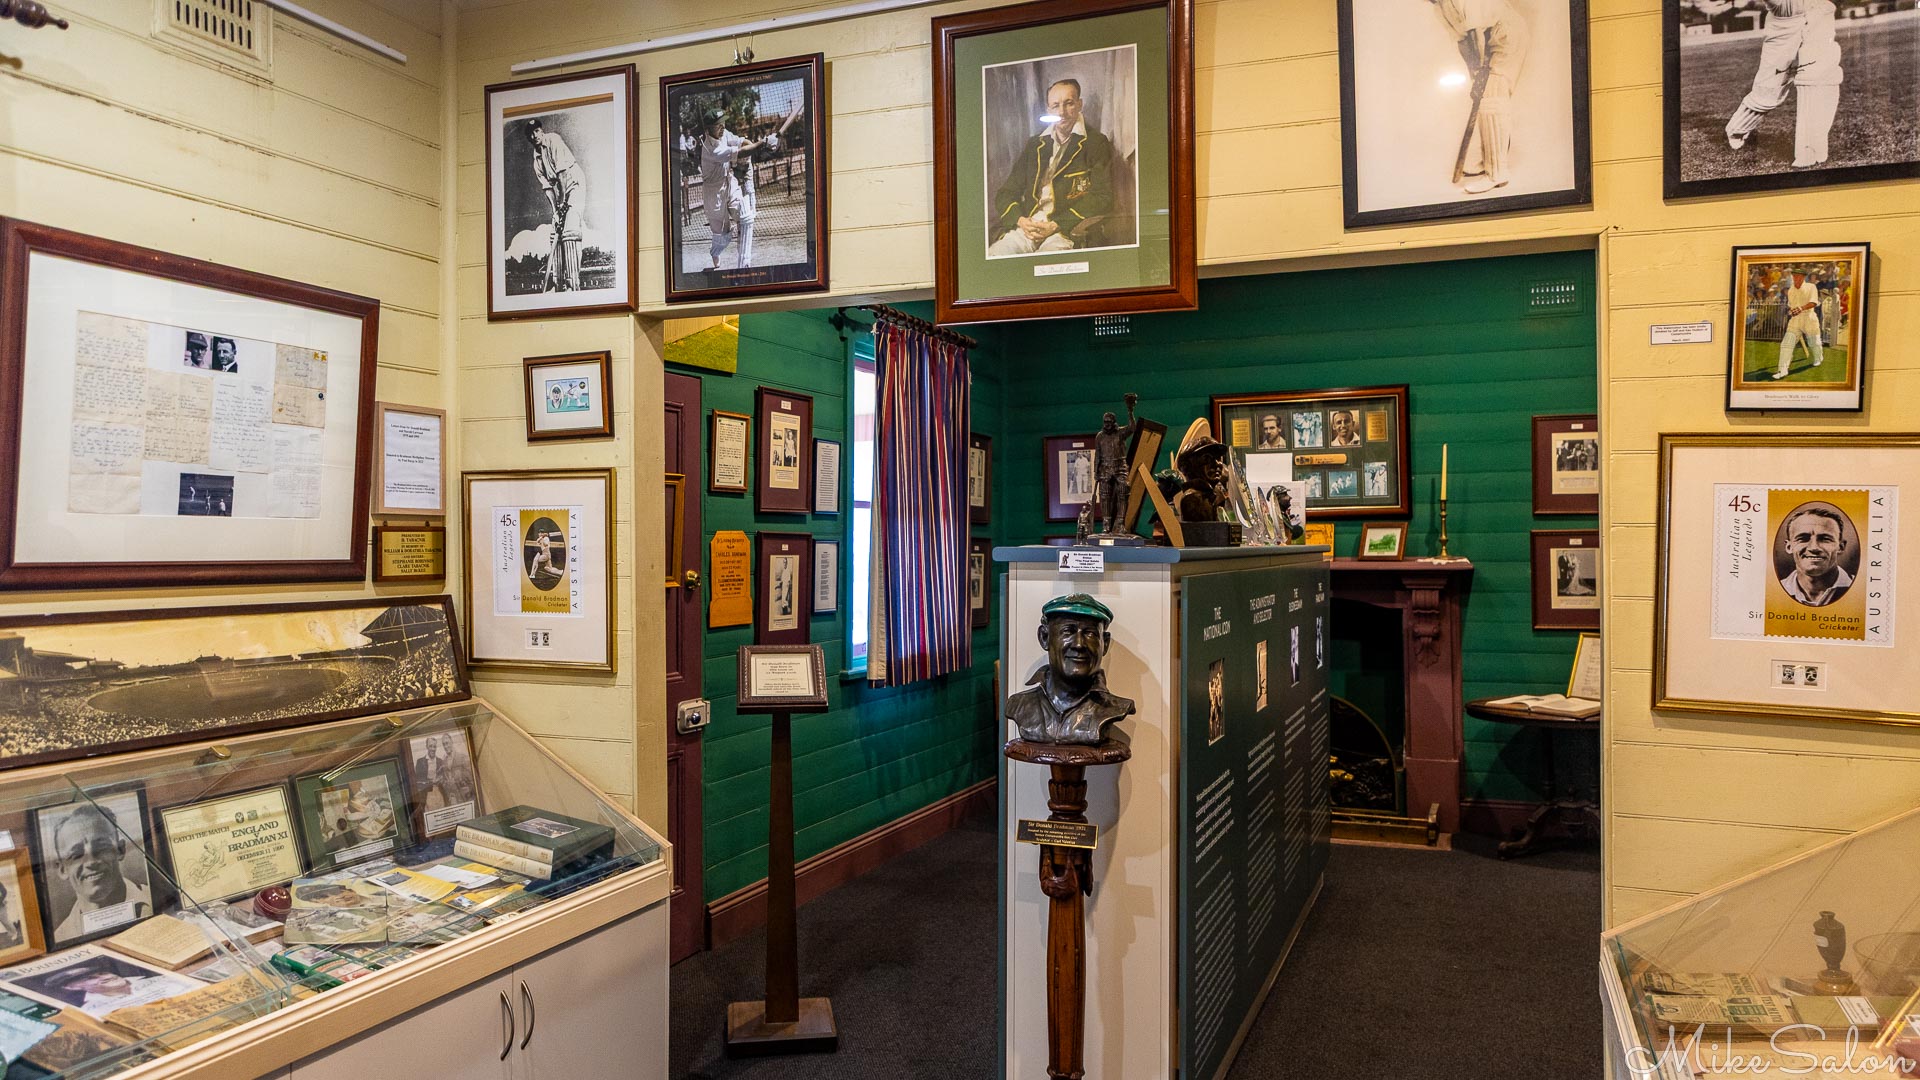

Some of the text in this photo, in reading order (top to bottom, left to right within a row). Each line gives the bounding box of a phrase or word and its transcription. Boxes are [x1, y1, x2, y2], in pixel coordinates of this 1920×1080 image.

[1728, 495, 1761, 513] 45c
[500, 513, 517, 527] 45c
[1730, 518, 1741, 579] Australian
[1742, 518, 1754, 561] Legends
[570, 513, 578, 609] AUSTRALIA
[1869, 496, 1884, 635] AUSTRALIA
[1214, 606, 1222, 621] THE
[1748, 611, 1860, 623] Sir Donald Bradman
[1203, 621, 1231, 641] NATIONAL ICON
[1818, 623, 1859, 632] Cricketer
[173, 826, 230, 844] CATCH THE MATCH
[231, 820, 279, 838] ENGLAND
[461, 830, 471, 839] THE
[471, 832, 500, 845] BRADMAN
[228, 831, 288, 853] BRADMAN XI
[237, 848, 265, 861] DECEMBER
[459, 845, 469, 854] THE
[469, 847, 497, 860] BRADMAN
[18, 948, 93, 975] BOUNDARY
[1761, 996, 1784, 1023] TEST MATCH
